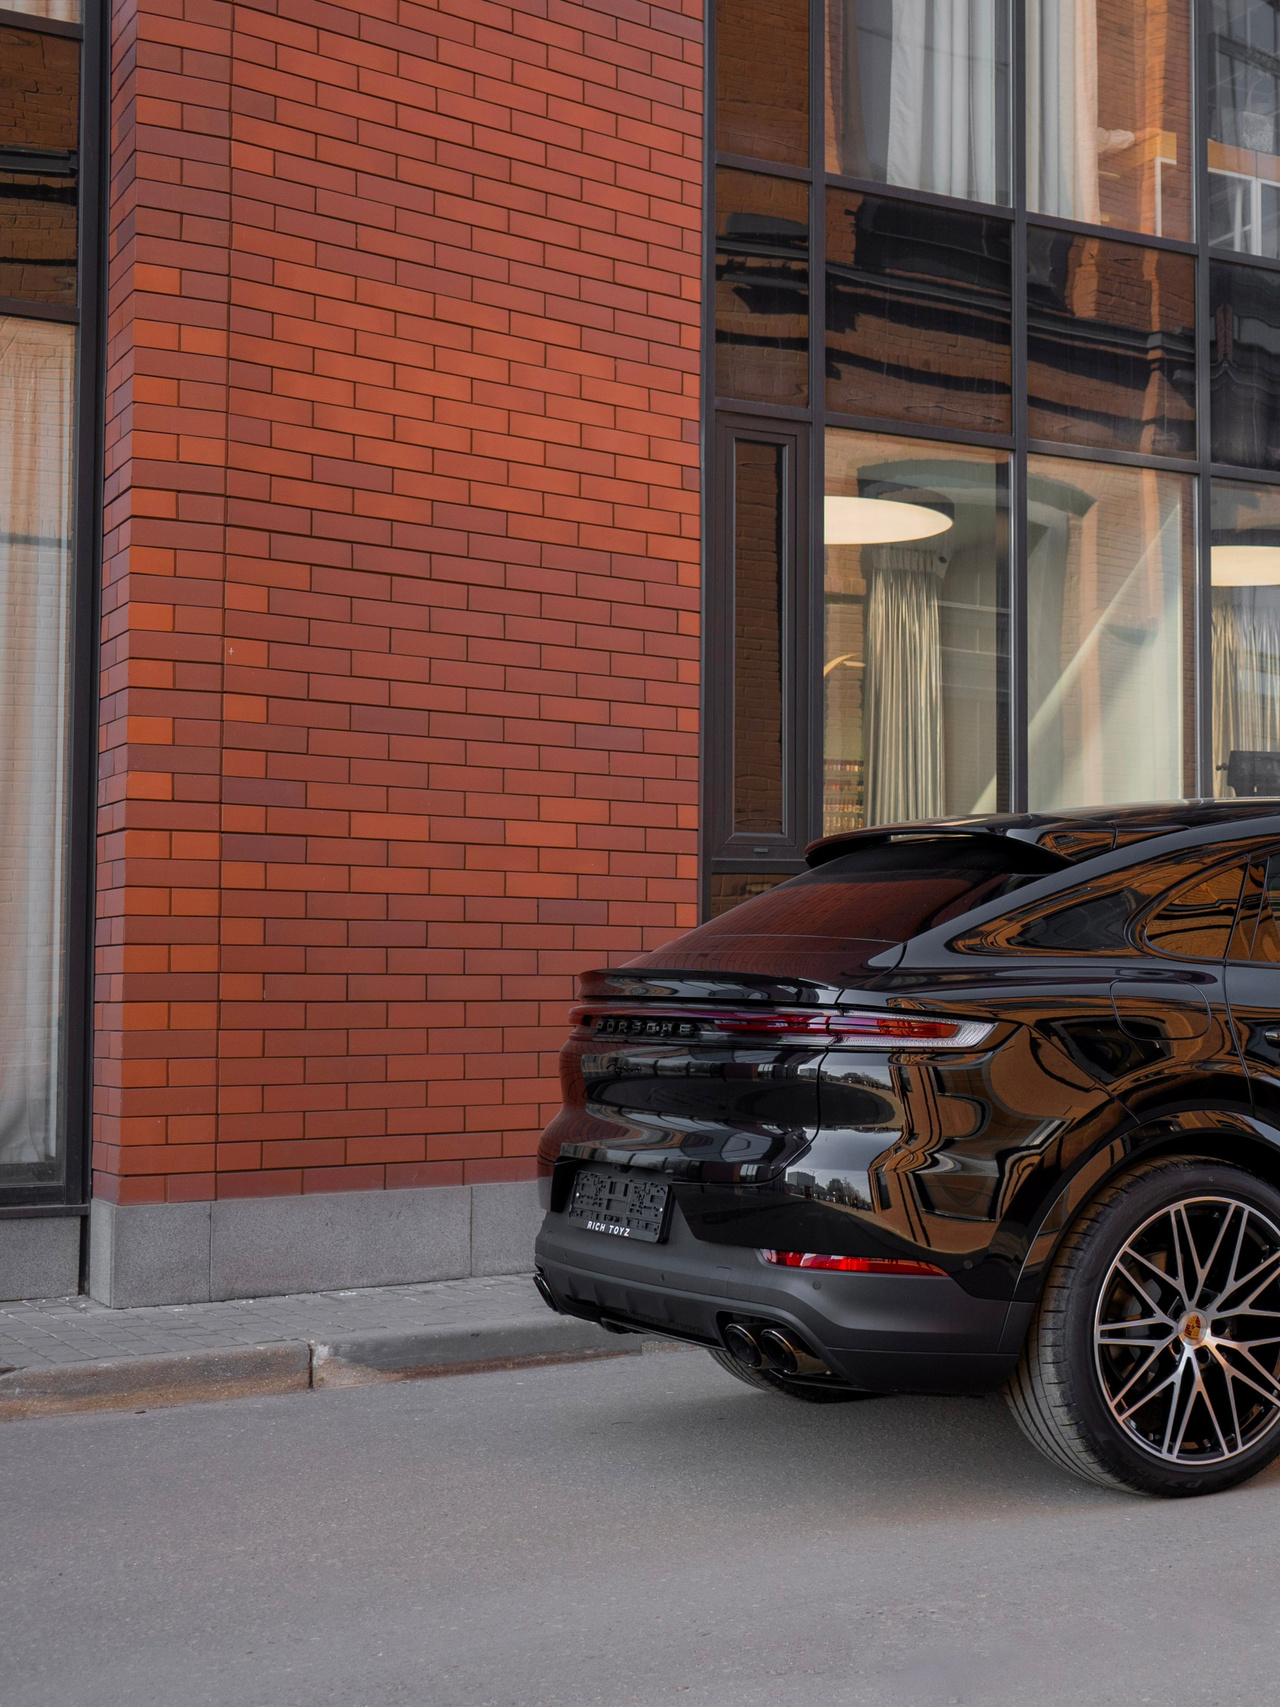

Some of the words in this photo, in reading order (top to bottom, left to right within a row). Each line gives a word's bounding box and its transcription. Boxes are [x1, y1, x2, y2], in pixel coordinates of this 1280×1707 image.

[597, 1019, 692, 1034] PORSCHE
[586, 1220, 606, 1232] RICH
[609, 1224, 631, 1236] TOYZ
